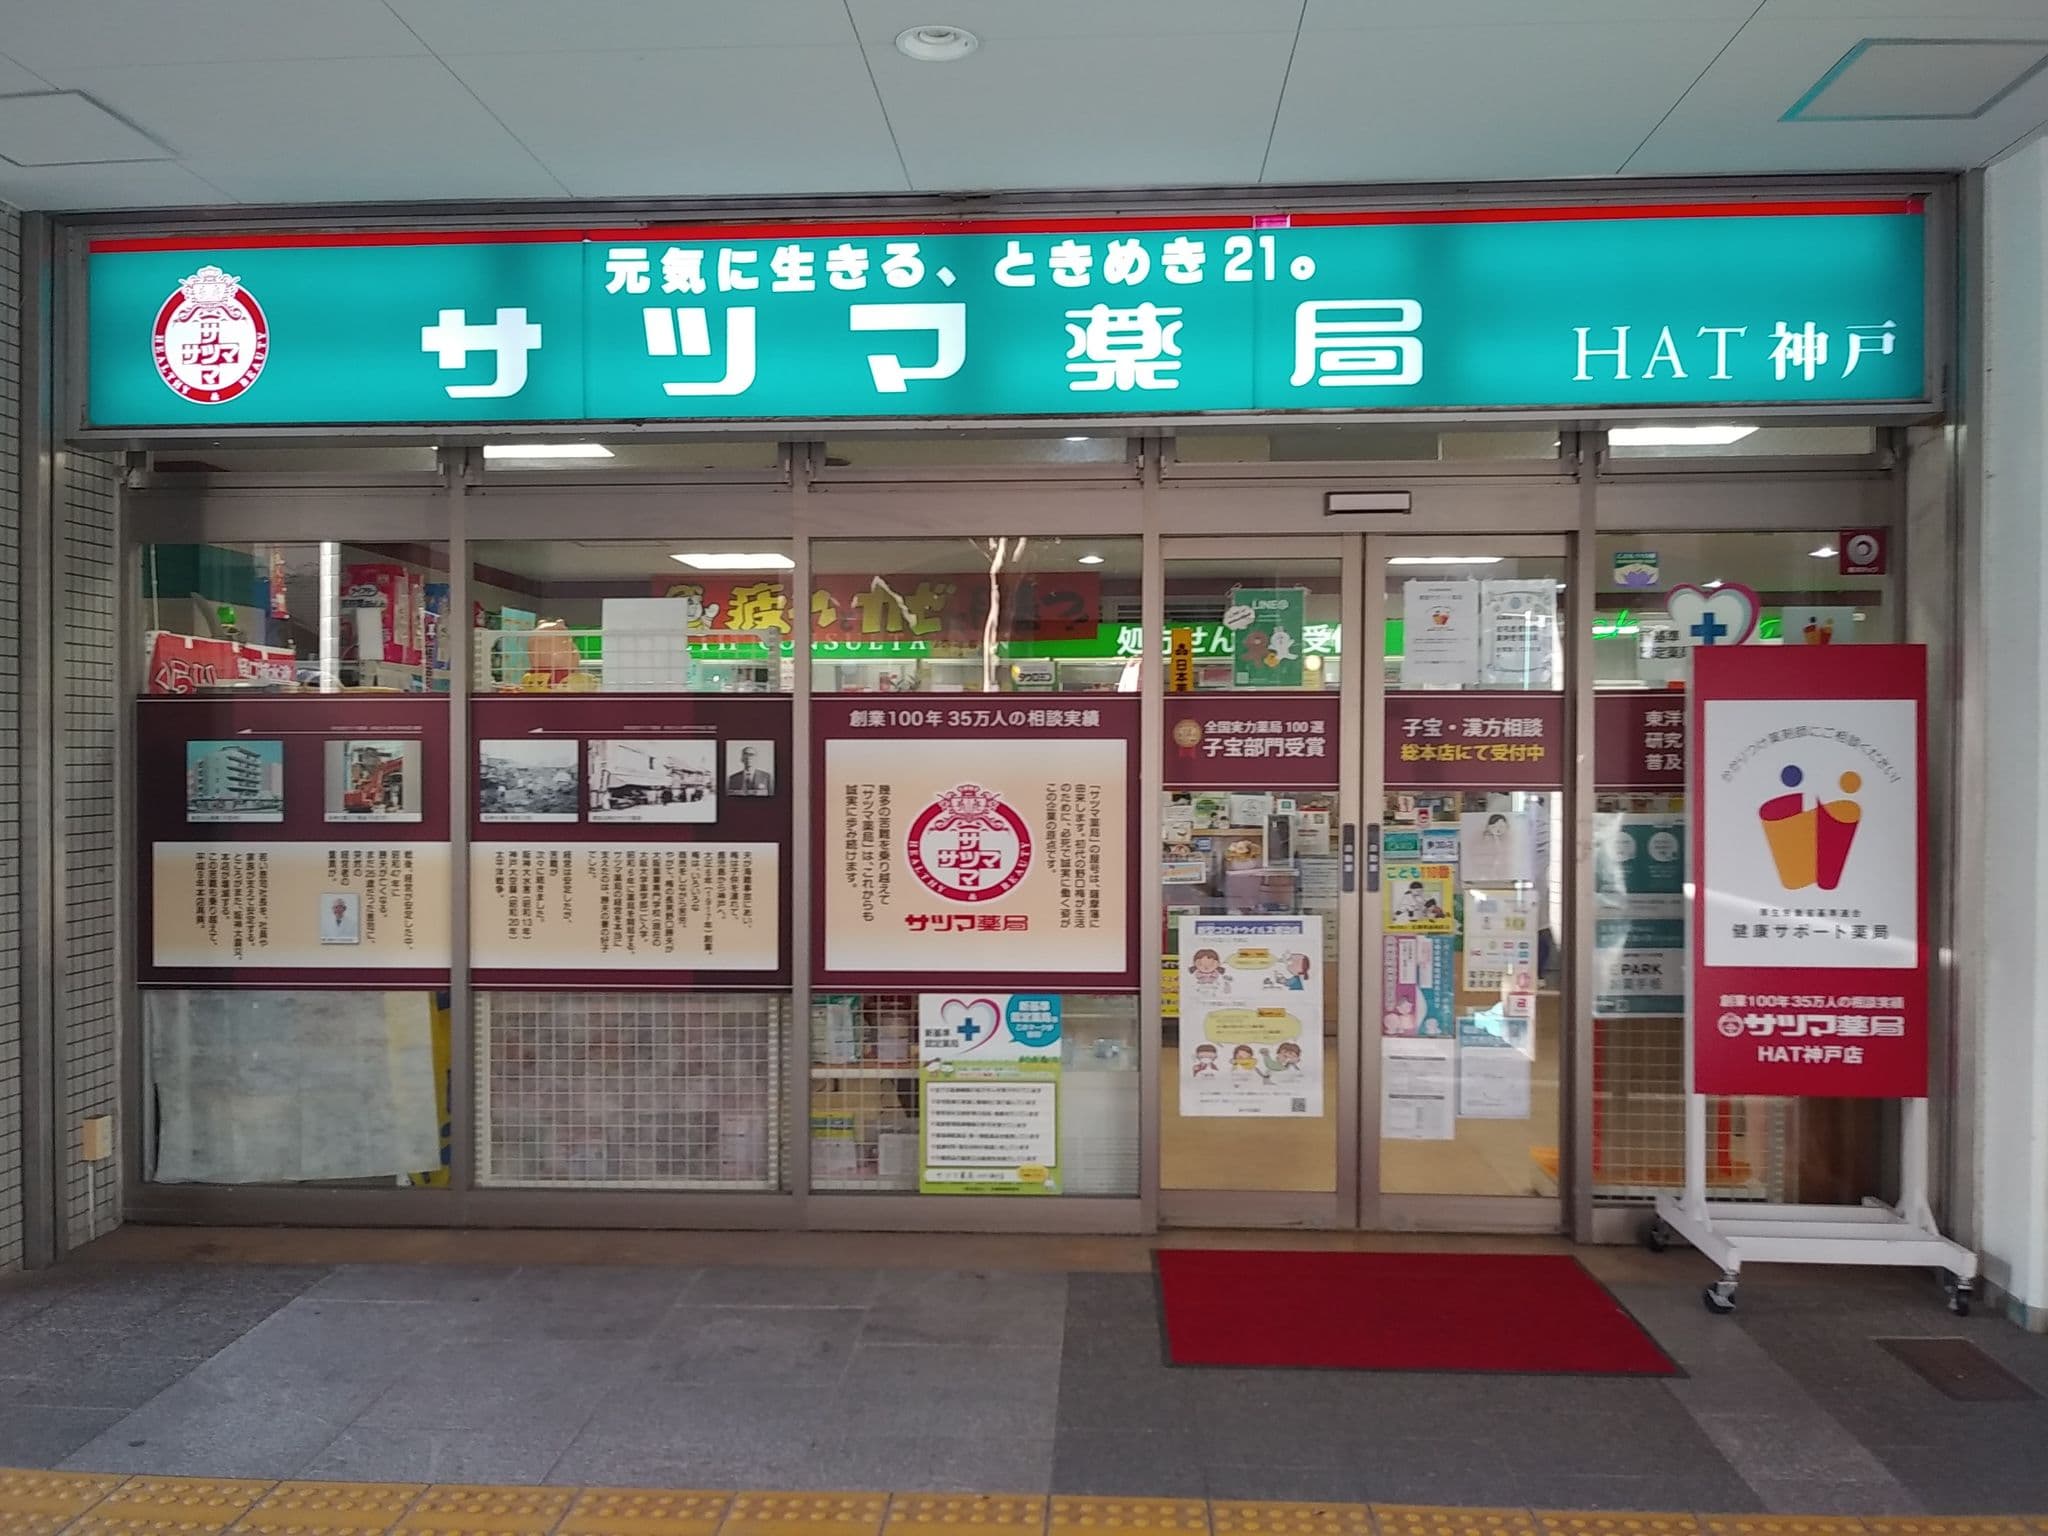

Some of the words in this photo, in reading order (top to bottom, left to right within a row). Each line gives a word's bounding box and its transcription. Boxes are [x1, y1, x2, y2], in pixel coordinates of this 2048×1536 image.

[421, 299, 1424, 400] サツマ薬局
[1302, 624, 1341, 654] 受
[849, 709, 943, 728] 創業100年
[947, 709, 1100, 728] 35万人の相談実績
[1204, 720, 1282, 734] 全国実力薬局
[1402, 717, 1544, 737] 子宝・漢方相談
[1643, 710, 1685, 727] 東洋
[1203, 737, 1326, 757] 子宝部門受賞
[1401, 743, 1545, 761] 総本店にて受付中
[908, 840, 947, 894] HEALTHY
[1001, 841, 1030, 891] BEAUTY
[905, 914, 1029, 932] サツマ薬局
[1731, 923, 1889, 940] 健康サポート薬局
[1743, 1013, 1906, 1037] サツマ薬局
[1757, 1046, 1865, 1065] HAT神戸店
